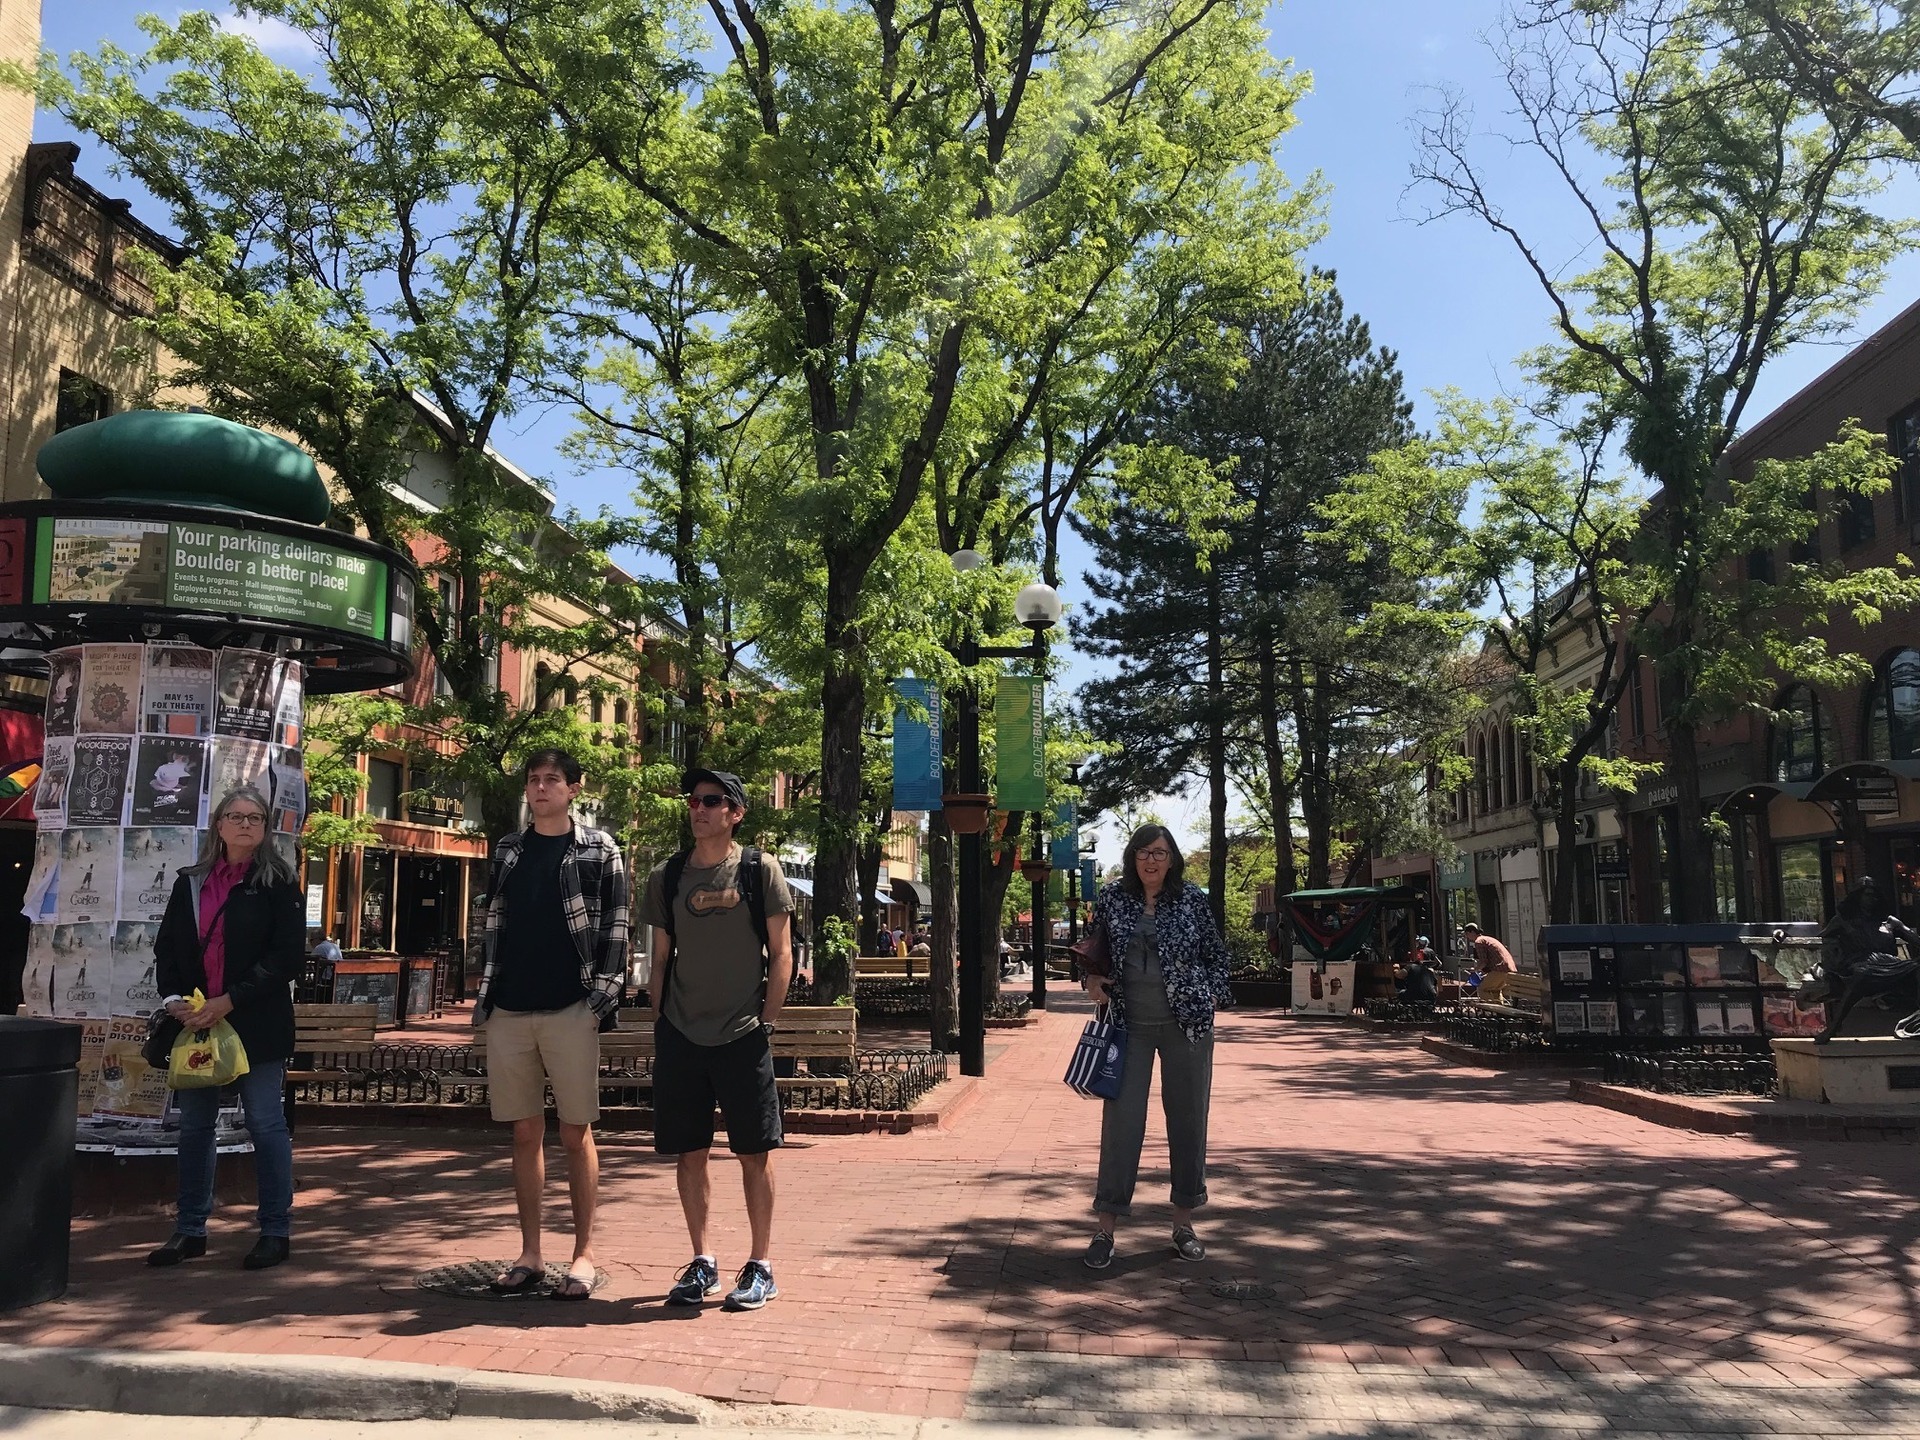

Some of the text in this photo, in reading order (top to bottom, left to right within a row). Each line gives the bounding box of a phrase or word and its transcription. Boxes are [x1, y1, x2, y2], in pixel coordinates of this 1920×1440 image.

[58, 520, 93, 528] PEARL
[122, 521, 165, 531] STREET
[175, 526, 366, 575] Your parking dollars make
[175, 549, 348, 592] Boulder a better place!
[174, 572, 198, 582] Events
[200, 575, 205, 583] &
[206, 577, 239, 587] programs
[245, 580, 260, 589] Mall
[260, 582, 303, 595] improvements
[174, 583, 208, 594] Employee
[209, 586, 222, 595] Eco
[223, 588, 239, 597] Pass
[245, 591, 276, 601] Economic
[276, 595, 298, 605] Vitality
[303, 599, 316, 608] Bike
[316, 601, 333, 611] Racks
[173, 594, 199, 604] Garage
[199, 597, 242, 608] construction
[248, 601, 273, 612] Parking
[273, 604, 306, 616] Operations
[113, 652, 137, 660] PINES
[105, 664, 132, 672] THEATRE
[148, 668, 212, 680] SANGO
[164, 693, 181, 701] MAY
[152, 702, 205, 711] FOX THEATRE
[224, 705, 241, 714] PITY
[242, 707, 255, 716] THE
[256, 709, 271, 718] FOOL
[929, 685, 940, 778] BOLDERBOULDER
[1032, 684, 1043, 778] BOLDERBOULDER
[112, 1022, 148, 1035] SOC
